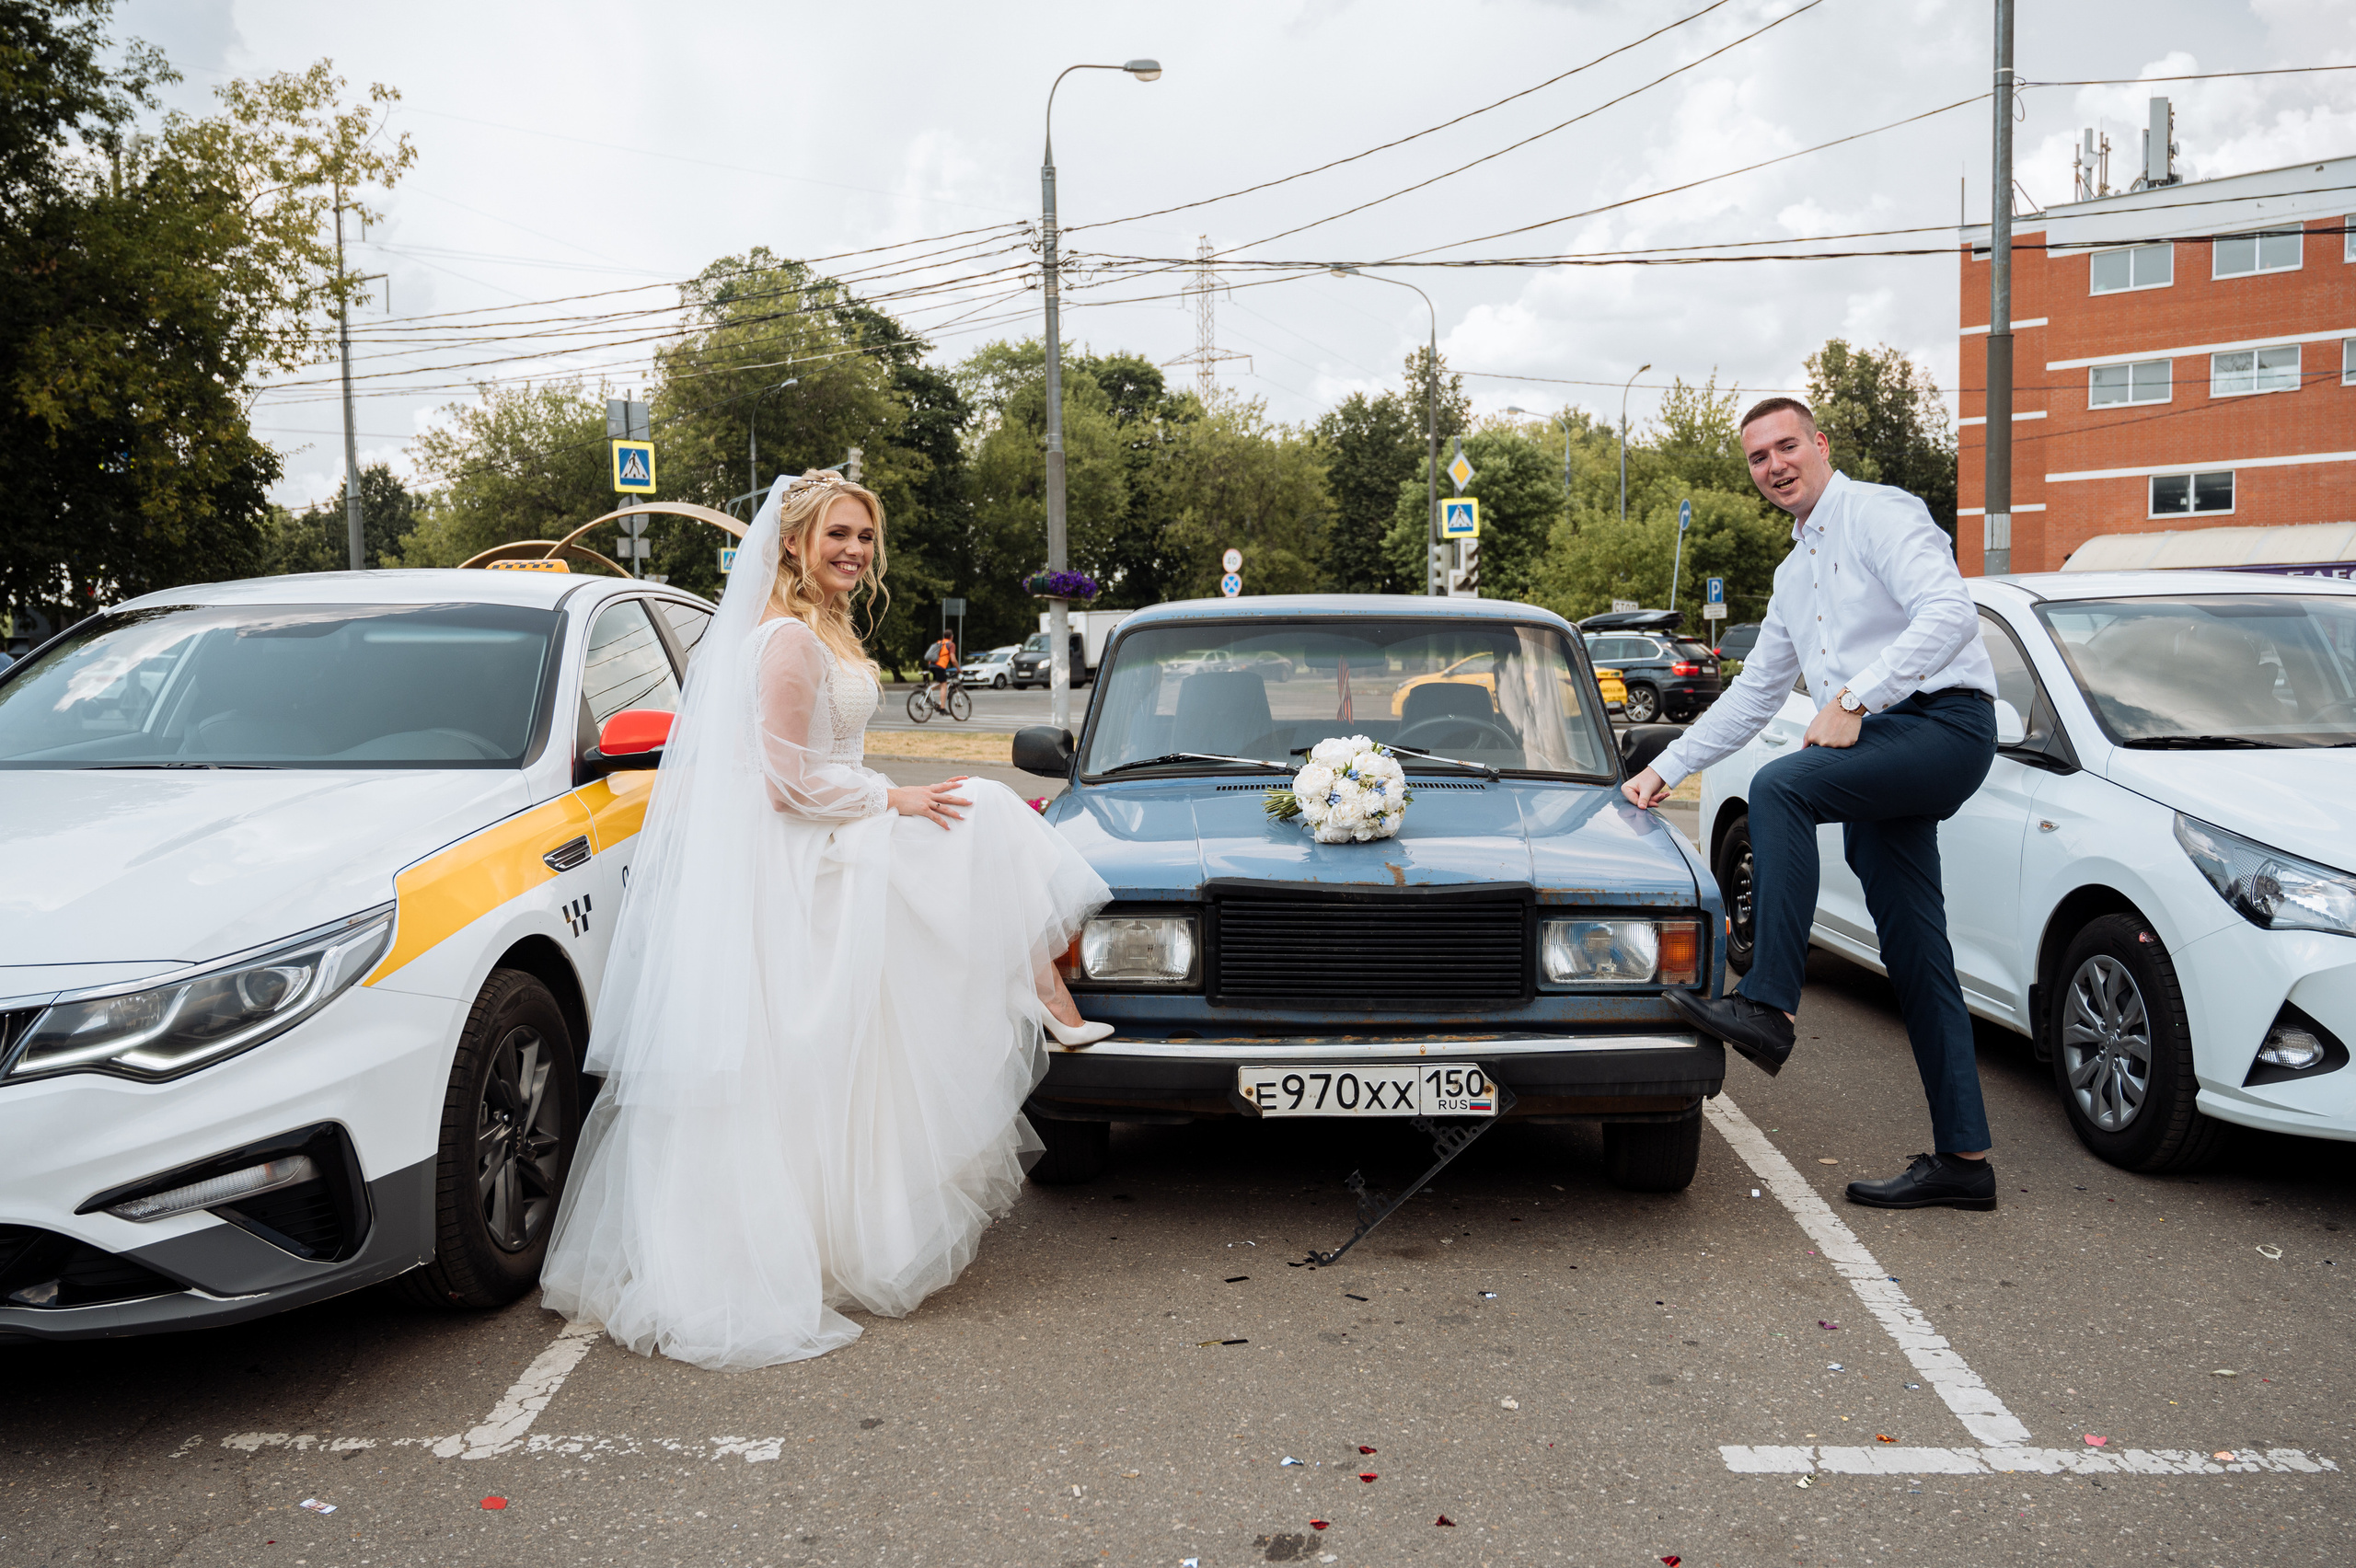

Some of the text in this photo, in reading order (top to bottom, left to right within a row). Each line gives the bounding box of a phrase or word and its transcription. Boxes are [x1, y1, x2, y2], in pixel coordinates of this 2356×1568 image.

[1712, 581, 1720, 601] P
[1426, 1069, 1484, 1098] 150
[1438, 1100, 1468, 1110] RUS
